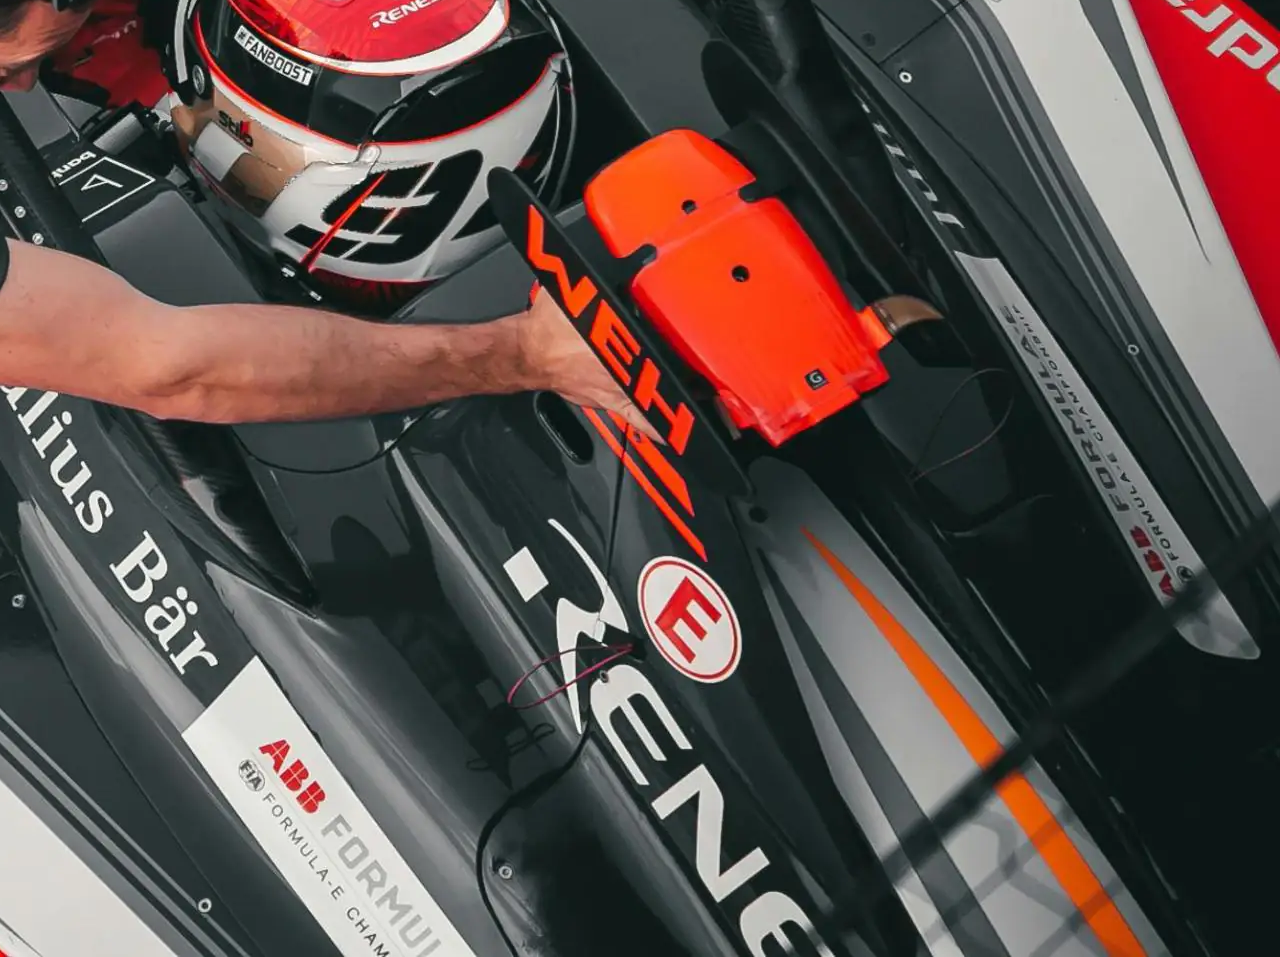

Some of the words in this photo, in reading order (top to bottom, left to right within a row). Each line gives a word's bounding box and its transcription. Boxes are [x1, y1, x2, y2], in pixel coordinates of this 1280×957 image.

[109, 530, 219, 675] Bär
[258, 739, 326, 814] ABB
[262, 793, 345, 901] FORMULA-E
